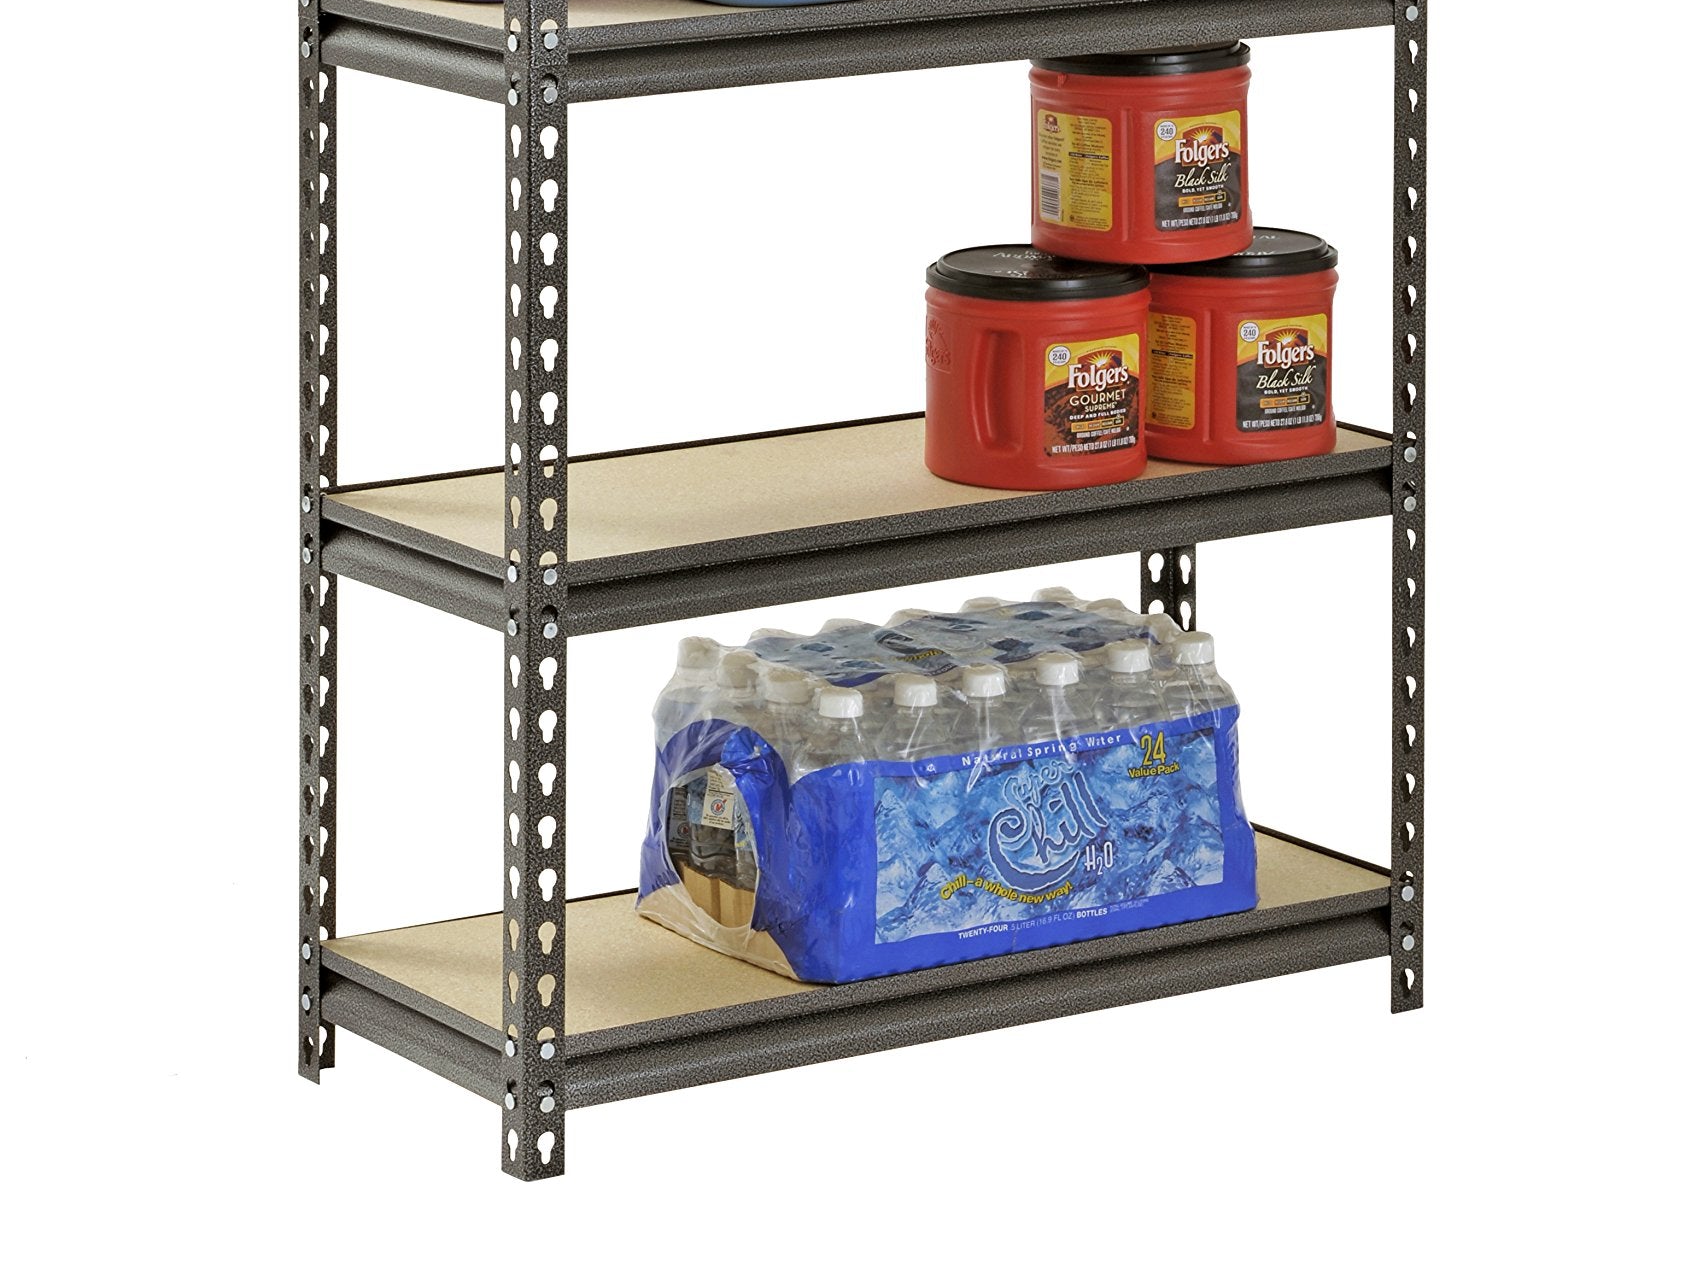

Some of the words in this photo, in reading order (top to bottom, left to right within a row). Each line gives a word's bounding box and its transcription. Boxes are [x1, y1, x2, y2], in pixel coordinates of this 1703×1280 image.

[1160, 127, 1174, 136] 240
[1175, 139, 1230, 167] Folgers
[1174, 167, 1210, 188] Black
[1208, 163, 1232, 184] Silk
[1243, 329, 1257, 338] 240
[1052, 352, 1067, 361] 240
[1257, 340, 1315, 369] Folgers
[1068, 364, 1129, 391] Folgers
[1256, 368, 1293, 389] Black
[1291, 365, 1316, 385] Silk
[1070, 389, 1127, 407] GOURMET
[1084, 403, 1115, 413] SUPREME
[1027, 741, 1077, 758] Spring
[1085, 734, 1122, 748] Water
[1140, 732, 1167, 766] 24
[1128, 767, 1156, 779] Value
[1156, 761, 1180, 776] Pack
[1003, 760, 1074, 807] Super
[989, 771, 1109, 893] Chill
[984, 880, 1018, 901] whole
[1018, 893, 1045, 904] new
[1044, 880, 1074, 902] way!
[958, 923, 1008, 940] TWENTY-FOUR
[1017, 920, 1036, 930] LITER
[1054, 913, 1062, 922] FL
[1076, 907, 1108, 919] BOTTLES
